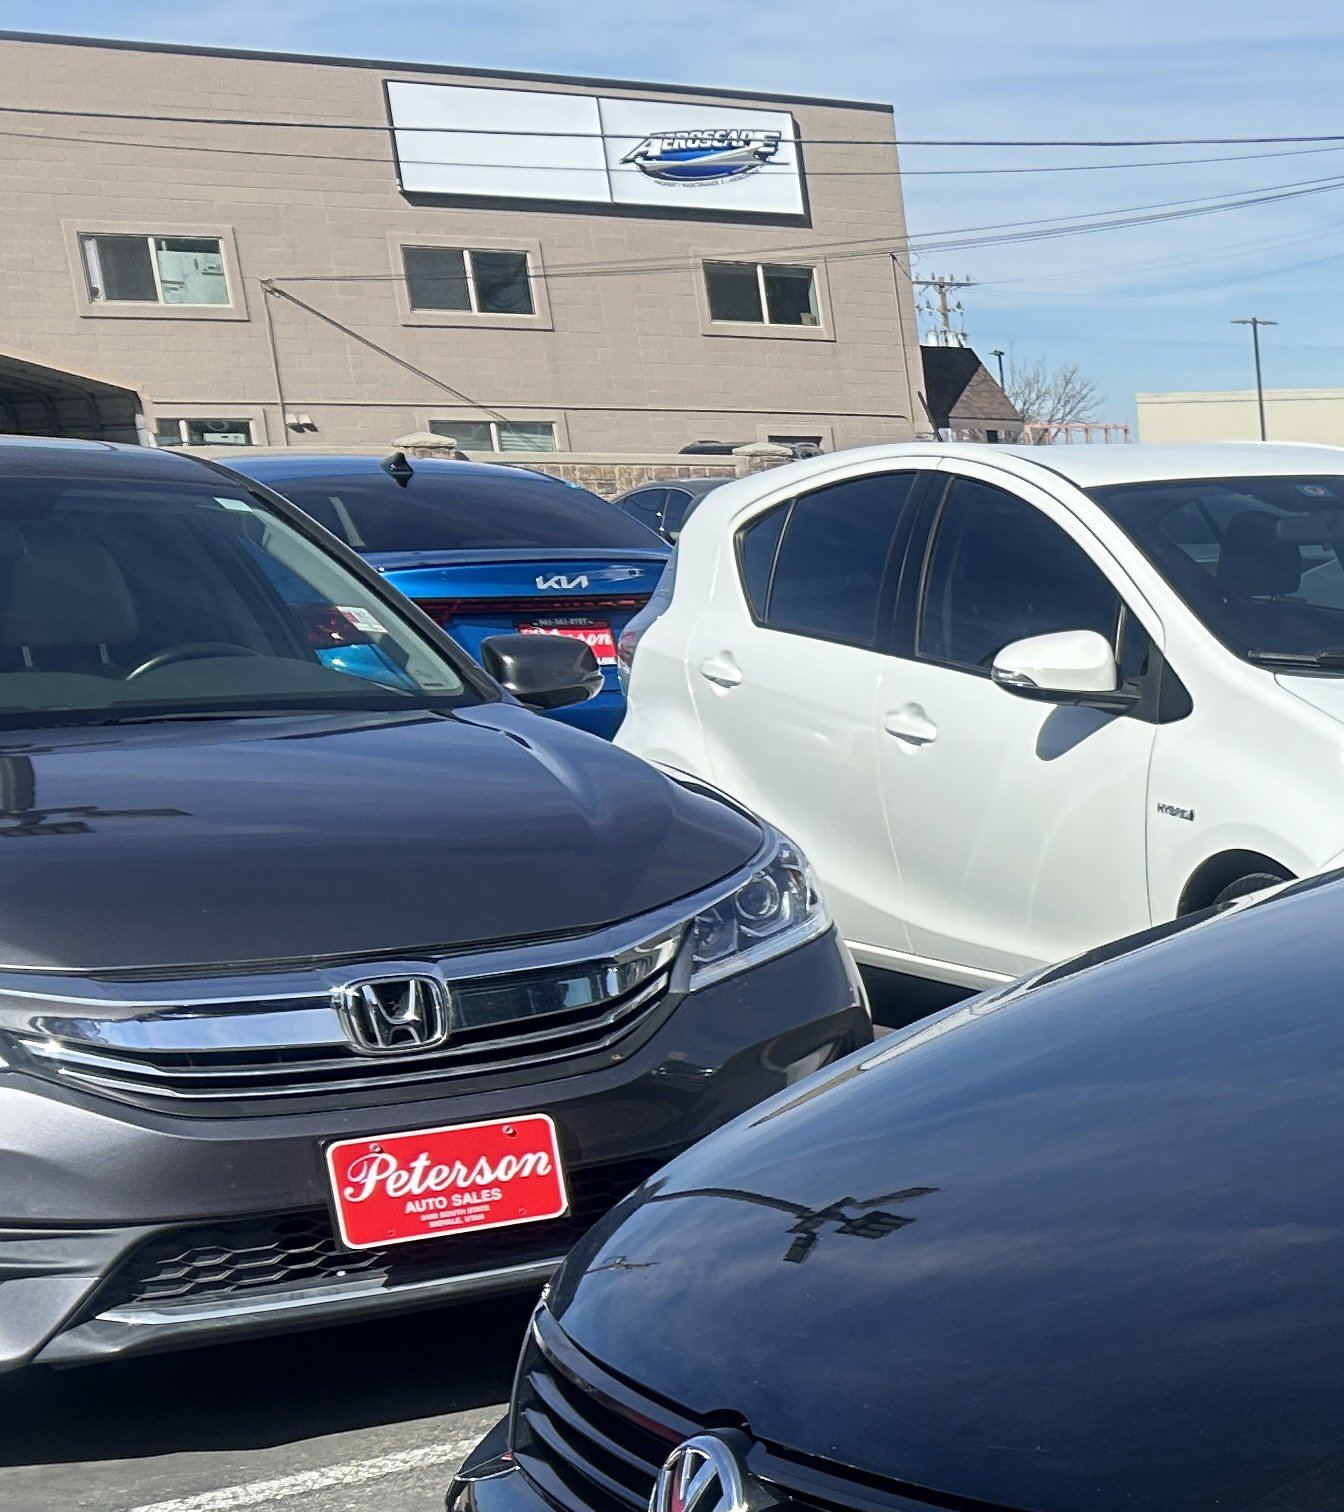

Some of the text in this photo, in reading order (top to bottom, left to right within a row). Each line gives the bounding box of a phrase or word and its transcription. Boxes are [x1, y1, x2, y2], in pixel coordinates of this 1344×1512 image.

[536, 576, 588, 589] KIA
[344, 1152, 552, 1202] Peterson
[405, 1187, 503, 1214] AUTO SALES
